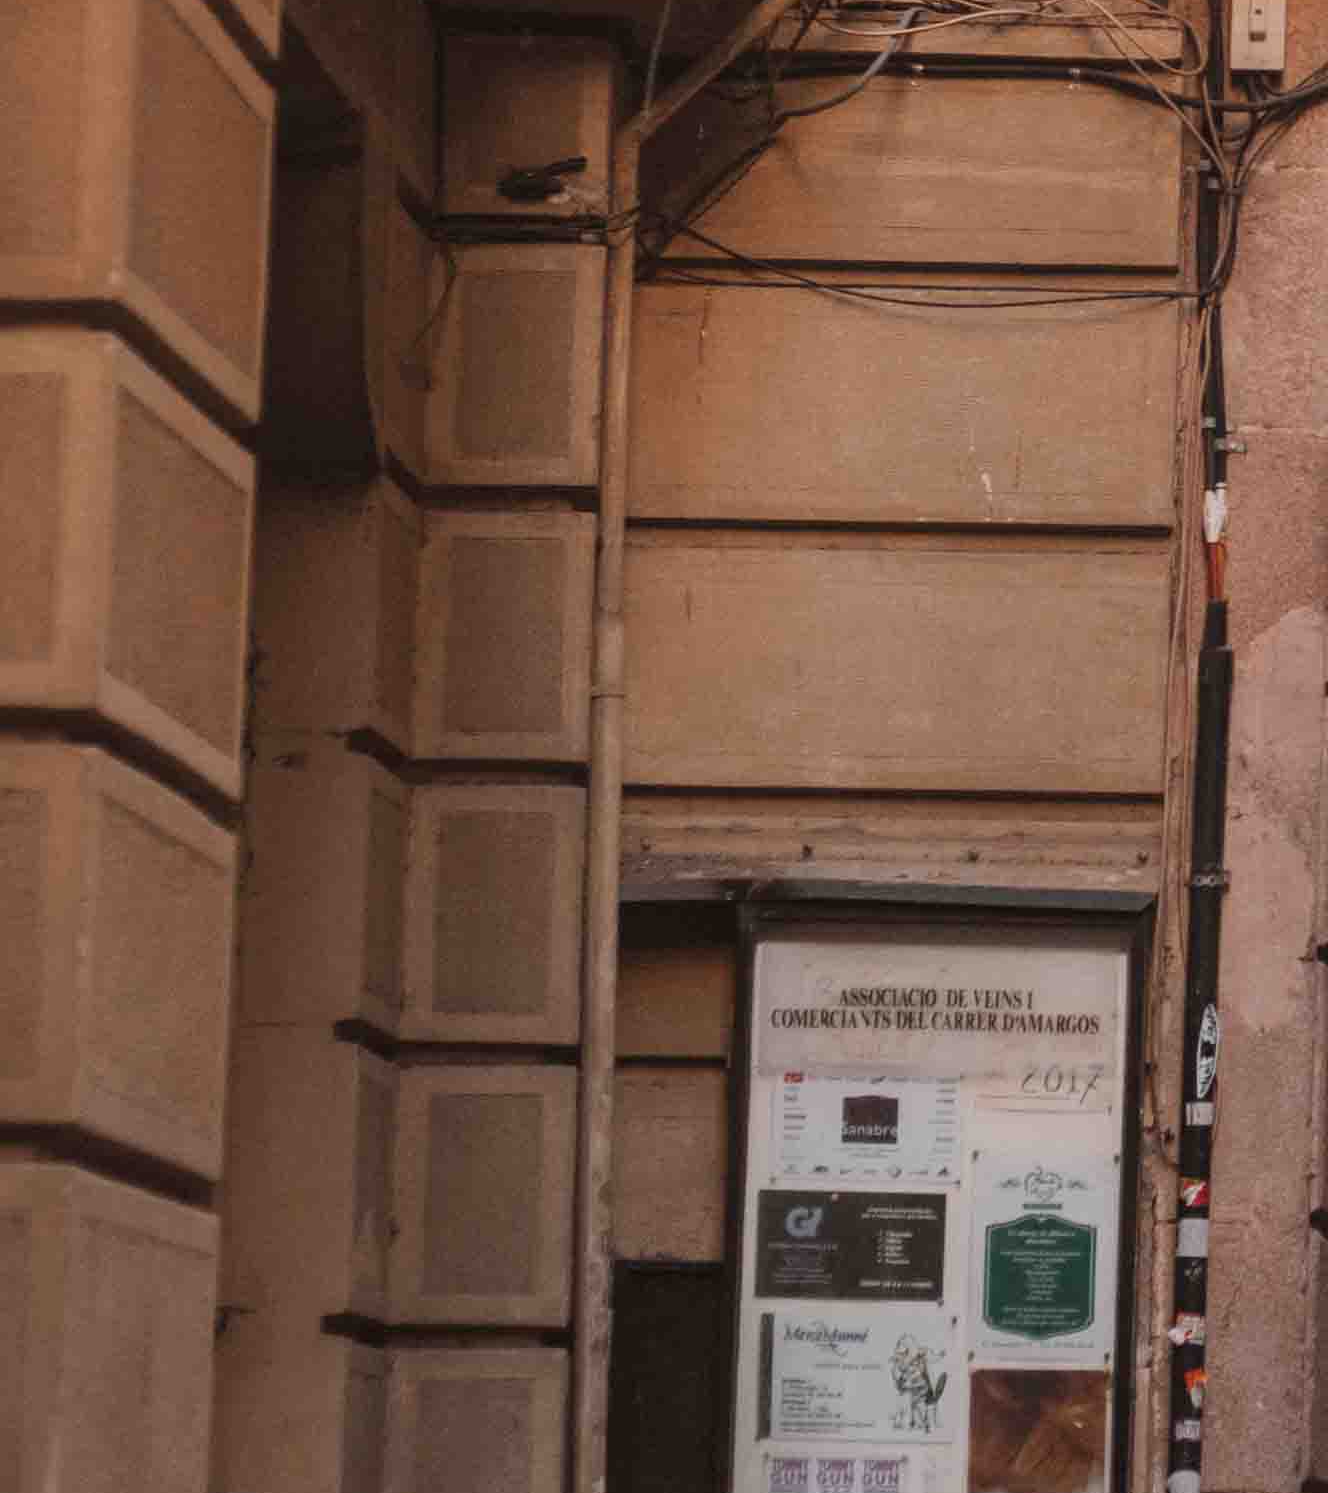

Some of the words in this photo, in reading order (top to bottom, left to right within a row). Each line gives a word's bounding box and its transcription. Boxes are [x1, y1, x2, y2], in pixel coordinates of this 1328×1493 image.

[946, 989, 968, 1009] DE
[972, 990, 1022, 1010] VEINS
[770, 1008, 892, 1030] COMERCIANTS
[894, 1010, 927, 1031] DEL
[930, 1011, 1001, 1032] CARRER
[1001, 1013, 1101, 1036] D'AMARGOS
[1019, 1063, 1104, 1106] 2017
